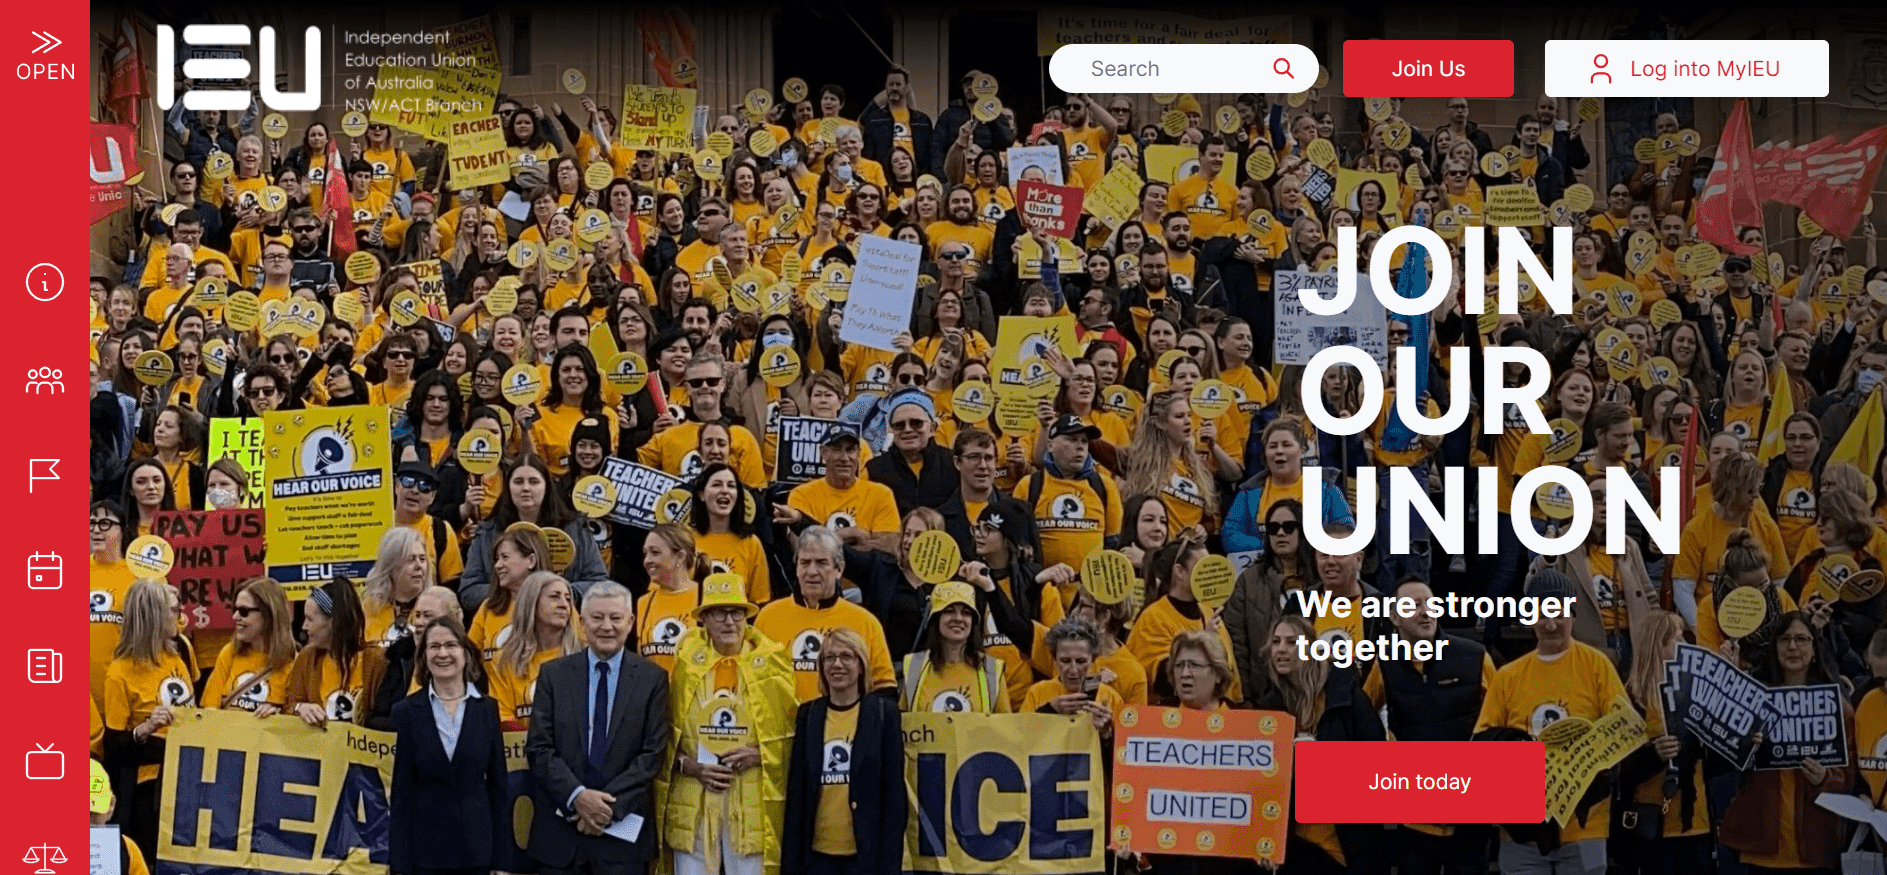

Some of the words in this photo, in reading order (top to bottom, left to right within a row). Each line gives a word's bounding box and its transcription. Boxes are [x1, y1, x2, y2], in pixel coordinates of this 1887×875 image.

[1135, 18, 1156, 30] for
[1162, 22, 1170, 33] a
[1174, 24, 1198, 39] fair
[1204, 26, 1239, 39] deal
[1249, 25, 1270, 37] for
[1026, 187, 1063, 204] More
[1028, 202, 1054, 216] than
[783, 420, 831, 442] TEAC
[792, 442, 827, 464] UNI
[1743, 440, 1759, 448] VOIC
[273, 480, 310, 496] HEAR
[310, 478, 339, 493] OUR
[340, 474, 381, 490] VOICE
[611, 480, 660, 512] UNITE
[158, 514, 207, 539] PAY
[222, 513, 262, 539] US
[1056, 520, 1074, 529] OUR
[1074, 520, 1099, 530] VOICE
[175, 544, 229, 569] HAT
[302, 563, 333, 581] IEU
[102, 614, 123, 624] VOIC
[657, 644, 676, 655] OUR
[795, 661, 815, 671] OUR
[700, 726, 717, 735] HEAR
[718, 726, 729, 735] OUR
[729, 727, 747, 735] VOICE
[347, 730, 398, 758] Indepe
[1128, 740, 1272, 767] TEACHERS
[825, 774, 845, 784] OUR
[172, 744, 391, 866] HEA
[917, 752, 1095, 863] ICE
[1150, 794, 1247, 820] UNITED
